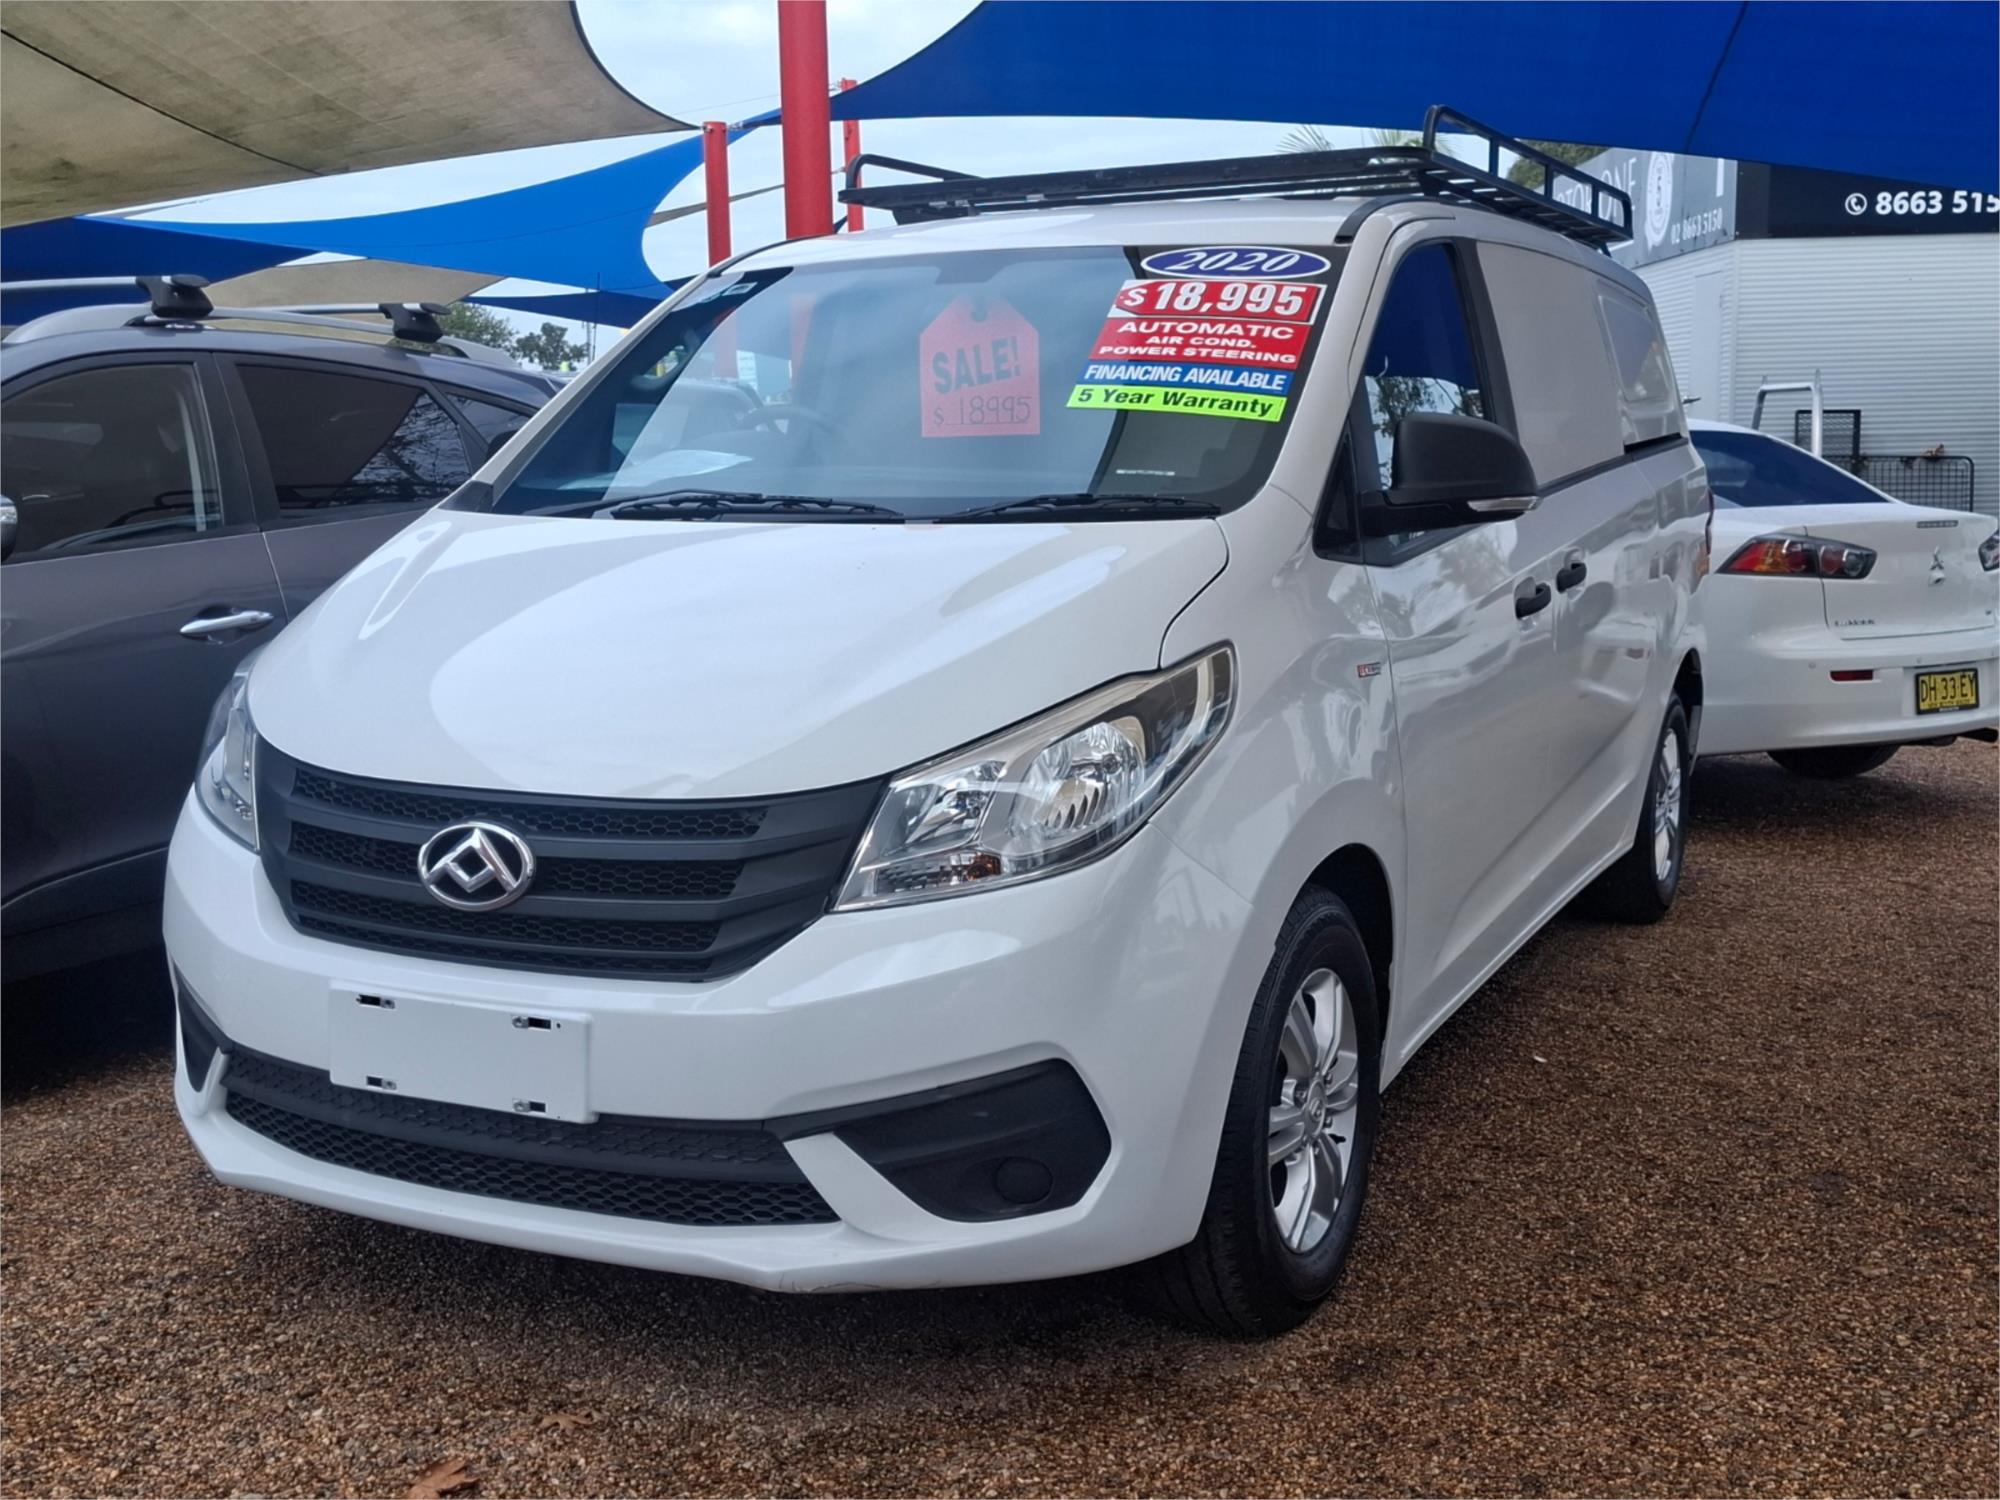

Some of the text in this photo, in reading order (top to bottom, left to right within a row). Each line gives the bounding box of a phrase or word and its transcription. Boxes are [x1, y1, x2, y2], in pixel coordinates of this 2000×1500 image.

[1875, 190, 1943, 215] 8663
[1682, 214, 1702, 241] 8663
[1702, 206, 1723, 234] 5150
[1164, 251, 1301, 273] 2020
[1117, 321, 1295, 339] AUTOMATIC
[1146, 336, 1257, 348] AIR COND.
[931, 335, 1021, 396] SALE!
[1099, 346, 1297, 364] POWER STEERING
[1084, 365, 1288, 391] FINANCING AVAILABLE
[1077, 389, 1274, 417] 5 Year Warranty
